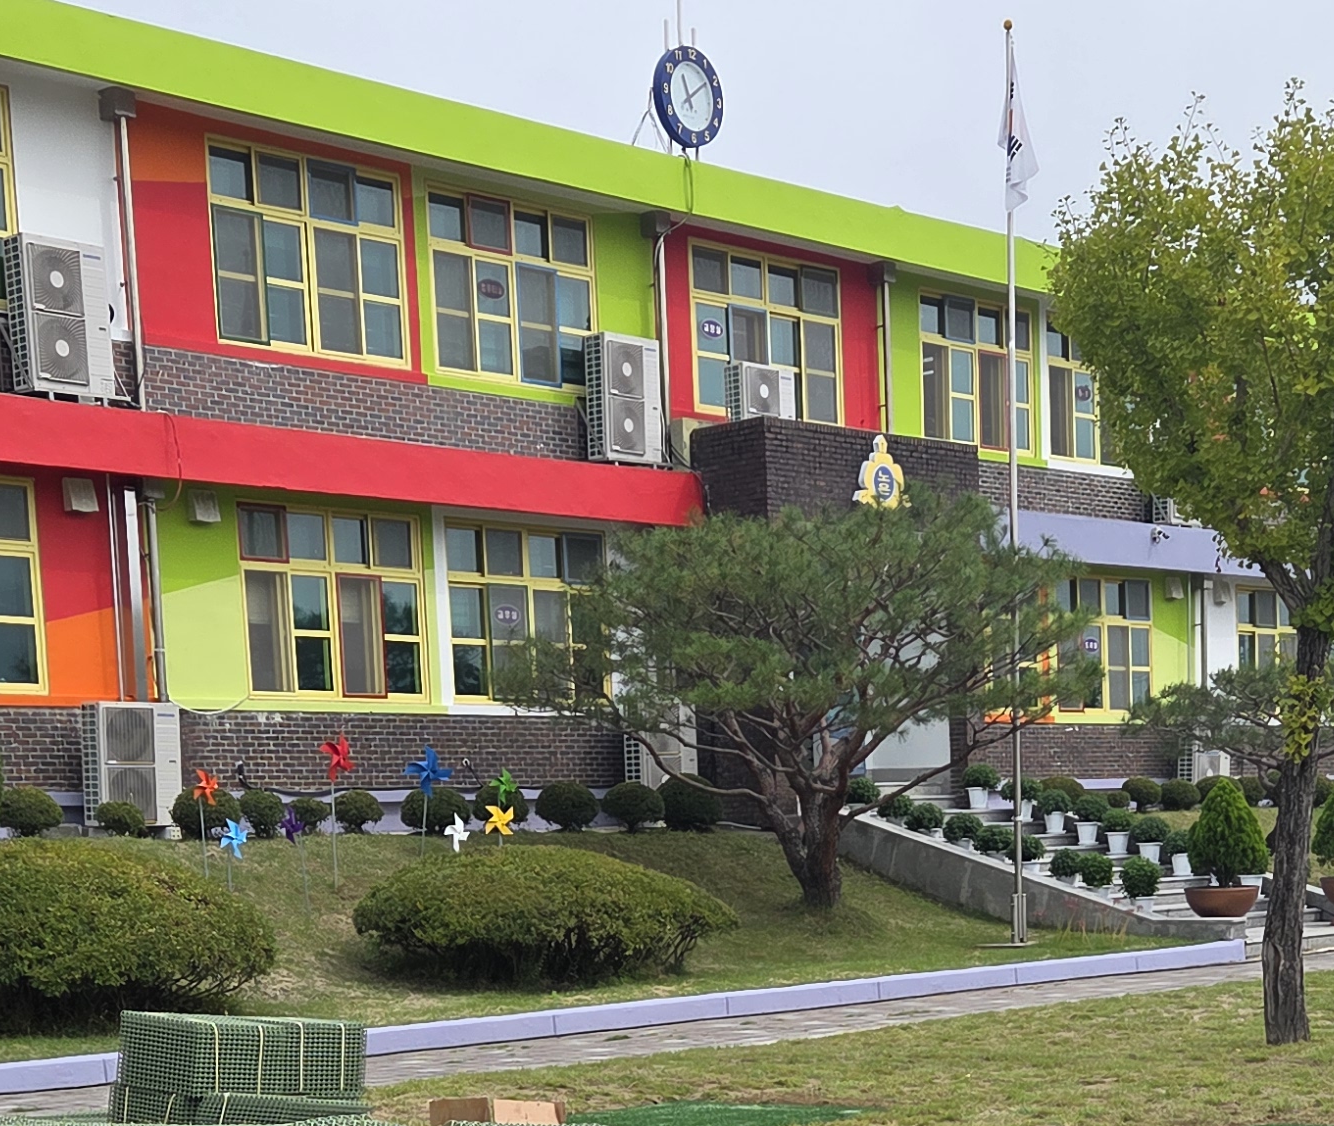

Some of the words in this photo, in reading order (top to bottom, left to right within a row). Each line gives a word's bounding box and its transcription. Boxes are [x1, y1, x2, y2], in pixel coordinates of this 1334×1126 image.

[674, 49, 683, 61] 11
[687, 48, 697, 60] 12
[665, 62, 674, 73] 10
[703, 58, 708, 69] 1
[712, 74, 719, 86] 2
[663, 82, 669, 94] 9
[716, 98, 722, 109] 3
[667, 104, 674, 116] 8
[676, 122, 683, 134] 7
[712, 118, 719, 128] 4
[690, 132, 697, 144] 6
[704, 131, 710, 142] 5
